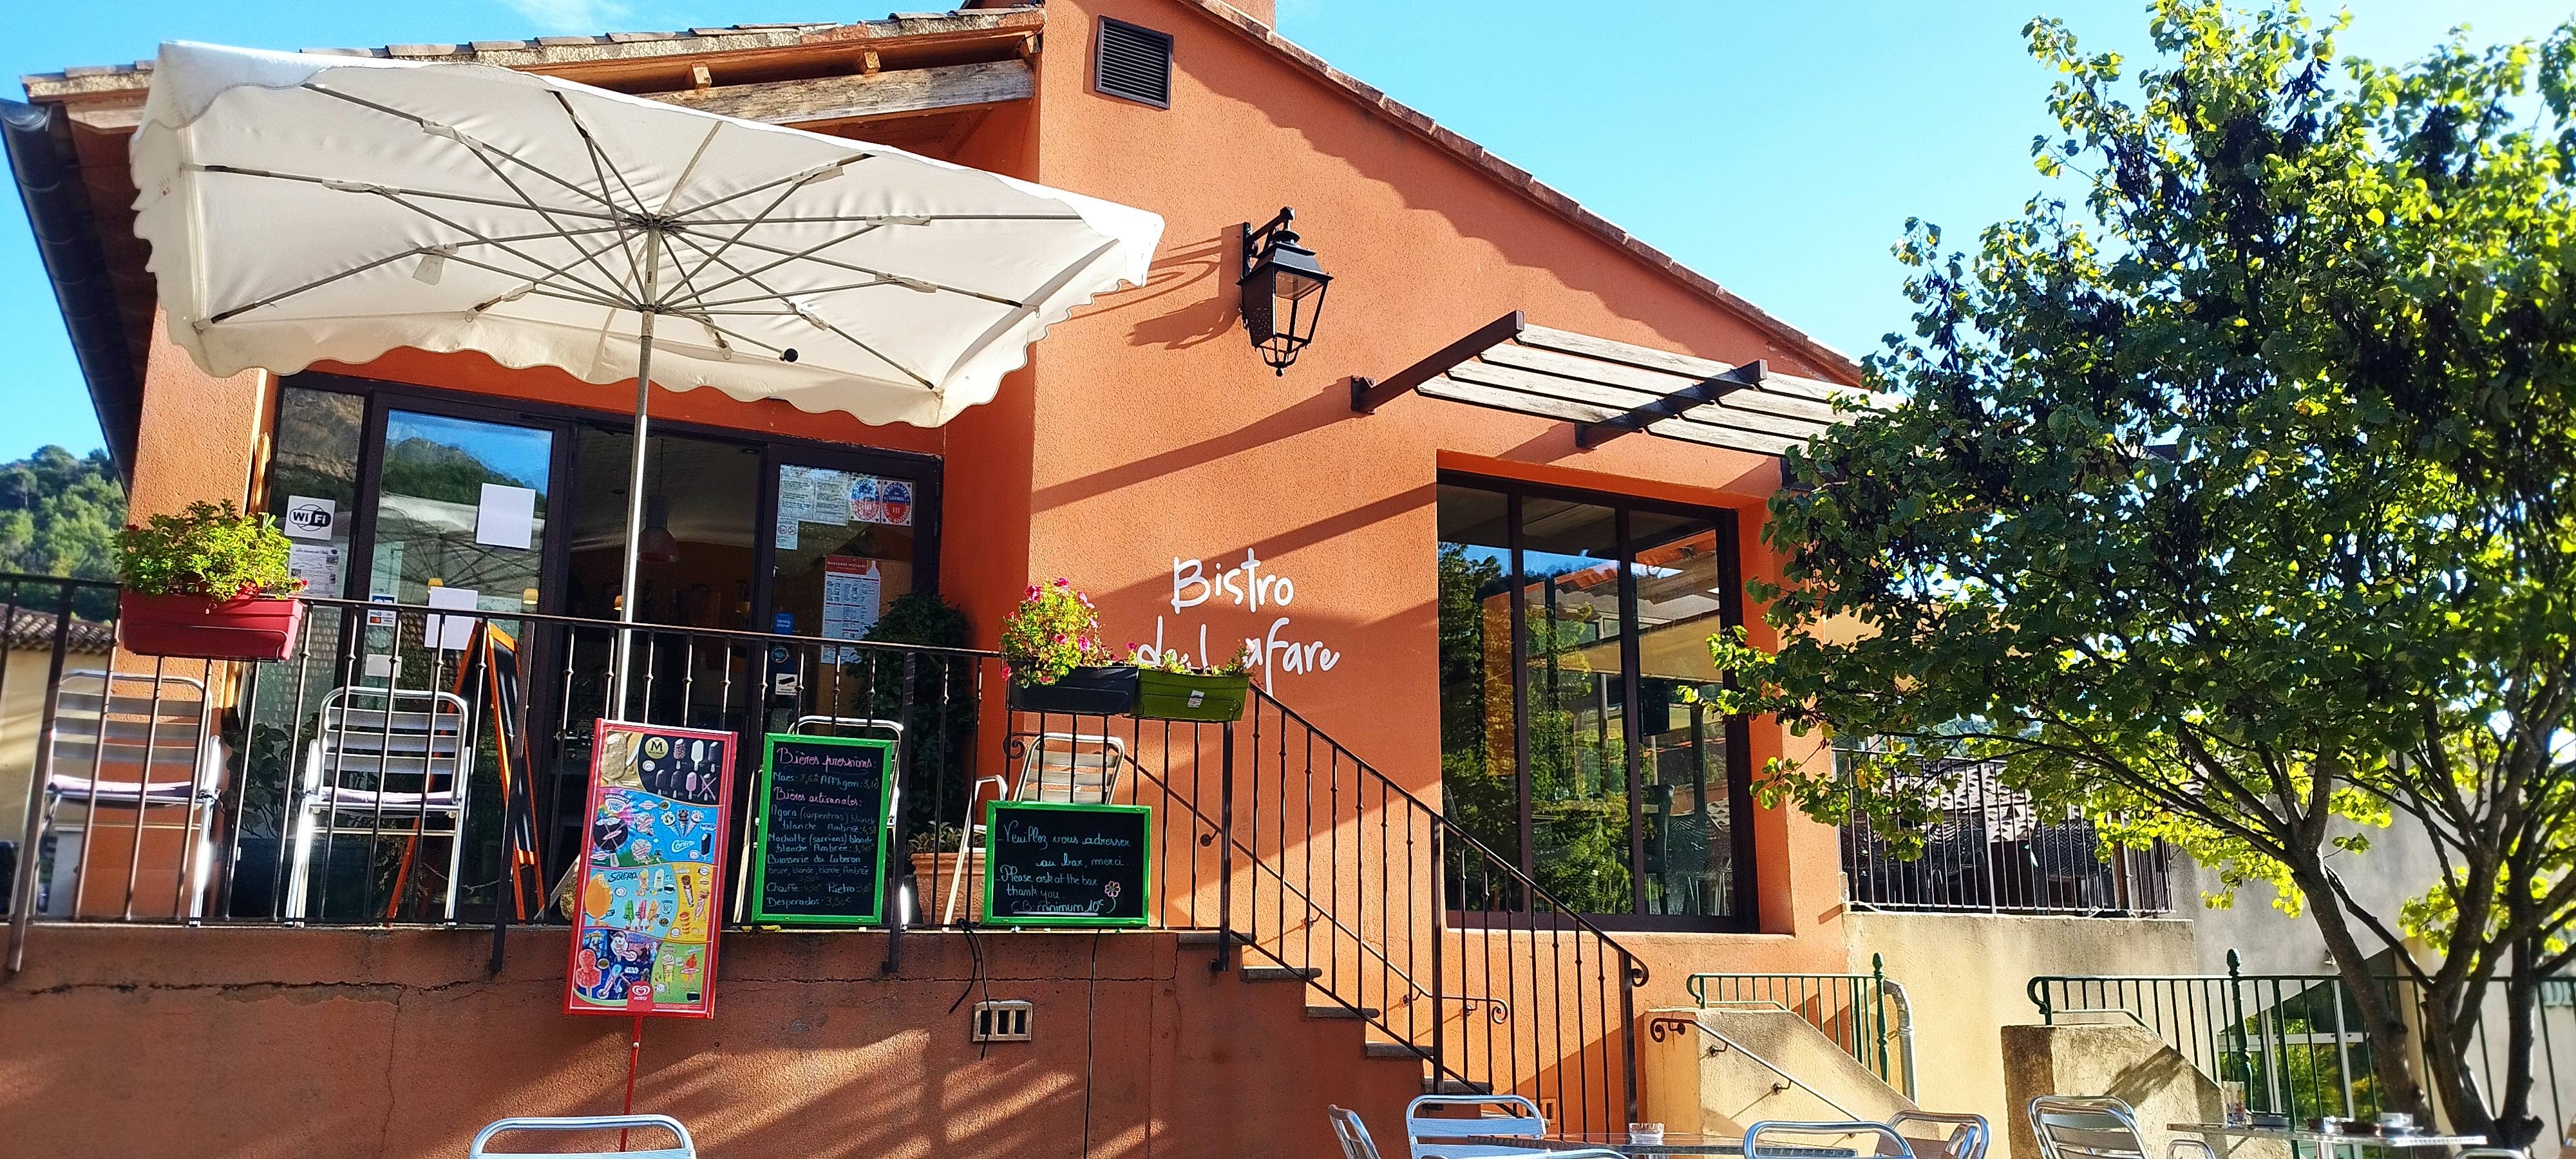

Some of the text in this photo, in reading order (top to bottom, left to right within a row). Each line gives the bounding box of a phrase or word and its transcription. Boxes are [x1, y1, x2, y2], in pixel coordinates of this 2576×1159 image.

[884, 482, 909, 498] VAUCLUSE
[1170, 547, 1294, 614] Bistro
[650, 740, 663, 752] M
[776, 747, 820, 765] Bières
[771, 805, 797, 822] Agora
[1052, 835, 1079, 844] vous
[1082, 833, 1131, 847] adresser
[829, 854, 861, 863] Luberon
[1036, 859, 1057, 867] au
[1036, 871, 1054, 884] ask
[1054, 873, 1065, 884] at
[1066, 873, 1080, 885] the
[1007, 883, 1037, 896] thank
[1037, 901, 1086, 912] minimum
